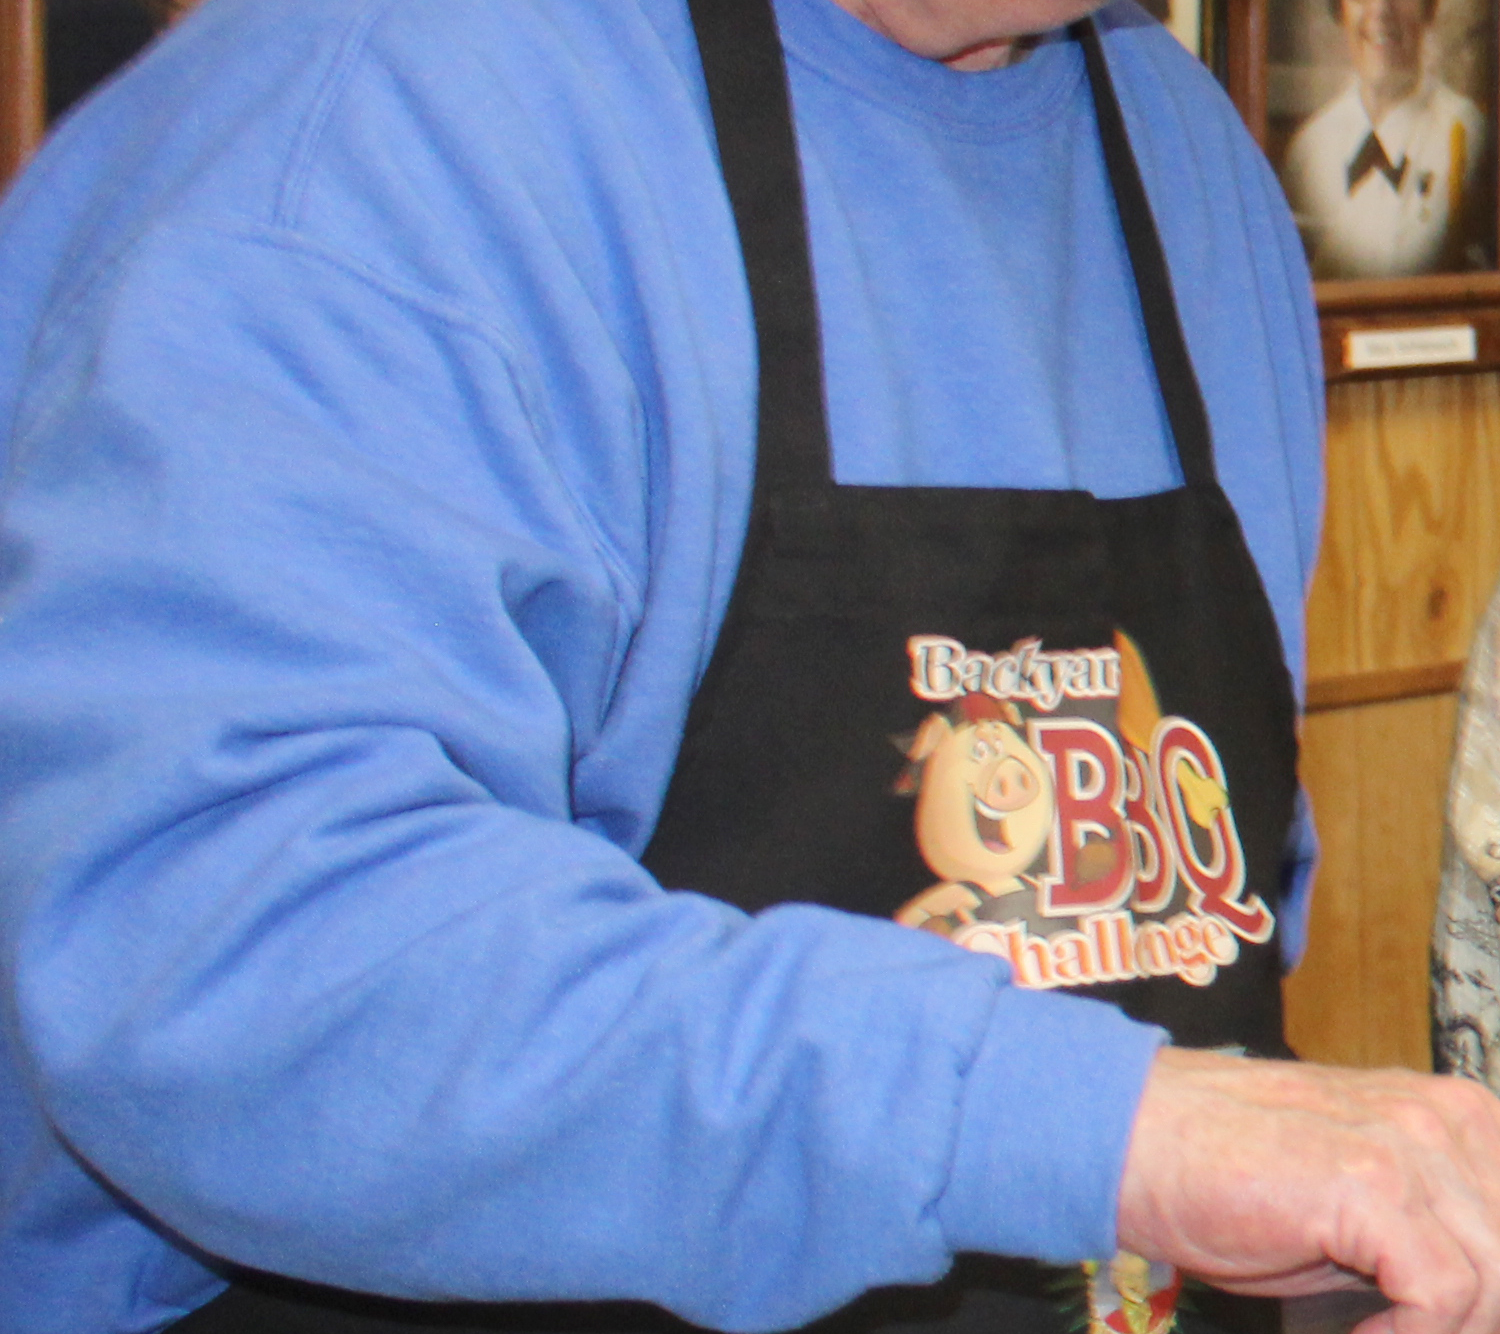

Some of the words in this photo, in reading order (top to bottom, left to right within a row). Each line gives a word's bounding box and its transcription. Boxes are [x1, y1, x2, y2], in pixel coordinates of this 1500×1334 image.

[908, 634, 1121, 712] Backyar
[1027, 715, 1275, 945] BBQ
[953, 910, 1240, 989] hallnge
